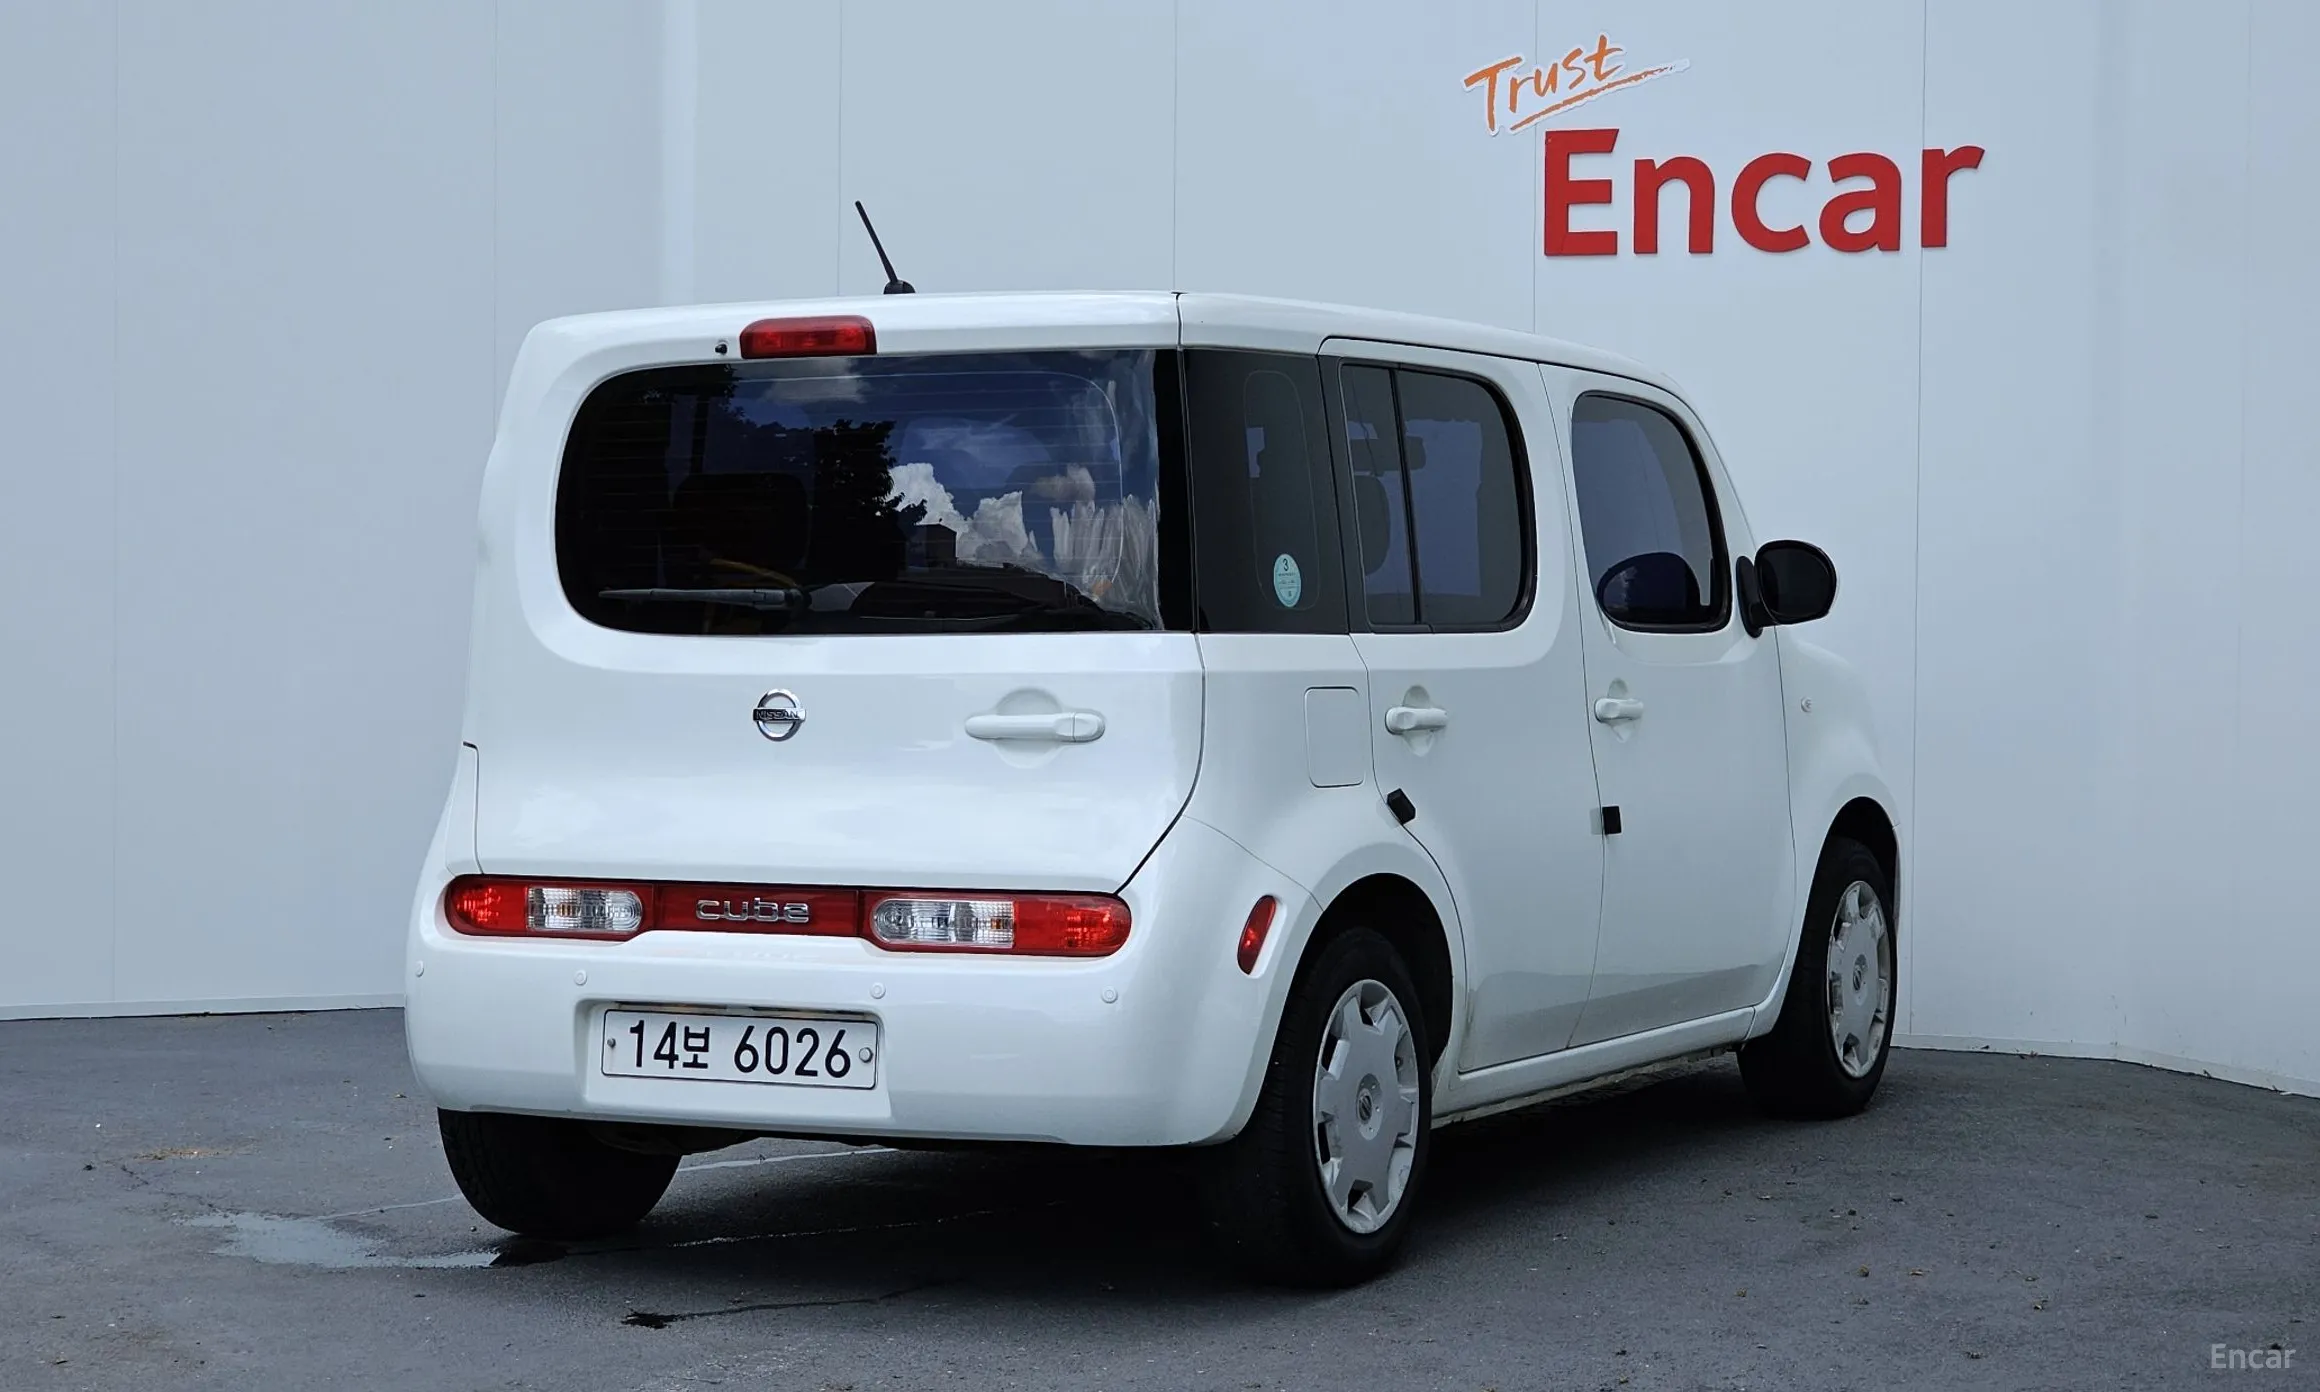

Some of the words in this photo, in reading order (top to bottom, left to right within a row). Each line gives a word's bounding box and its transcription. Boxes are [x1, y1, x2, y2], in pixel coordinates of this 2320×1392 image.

[1463, 34, 1624, 131] Trust
[1544, 128, 1986, 257] Encar
[756, 709, 800, 720] NISSAN
[696, 897, 810, 924] cube
[629, 1019, 711, 1070] 14보
[733, 1024, 851, 1079] 6026
